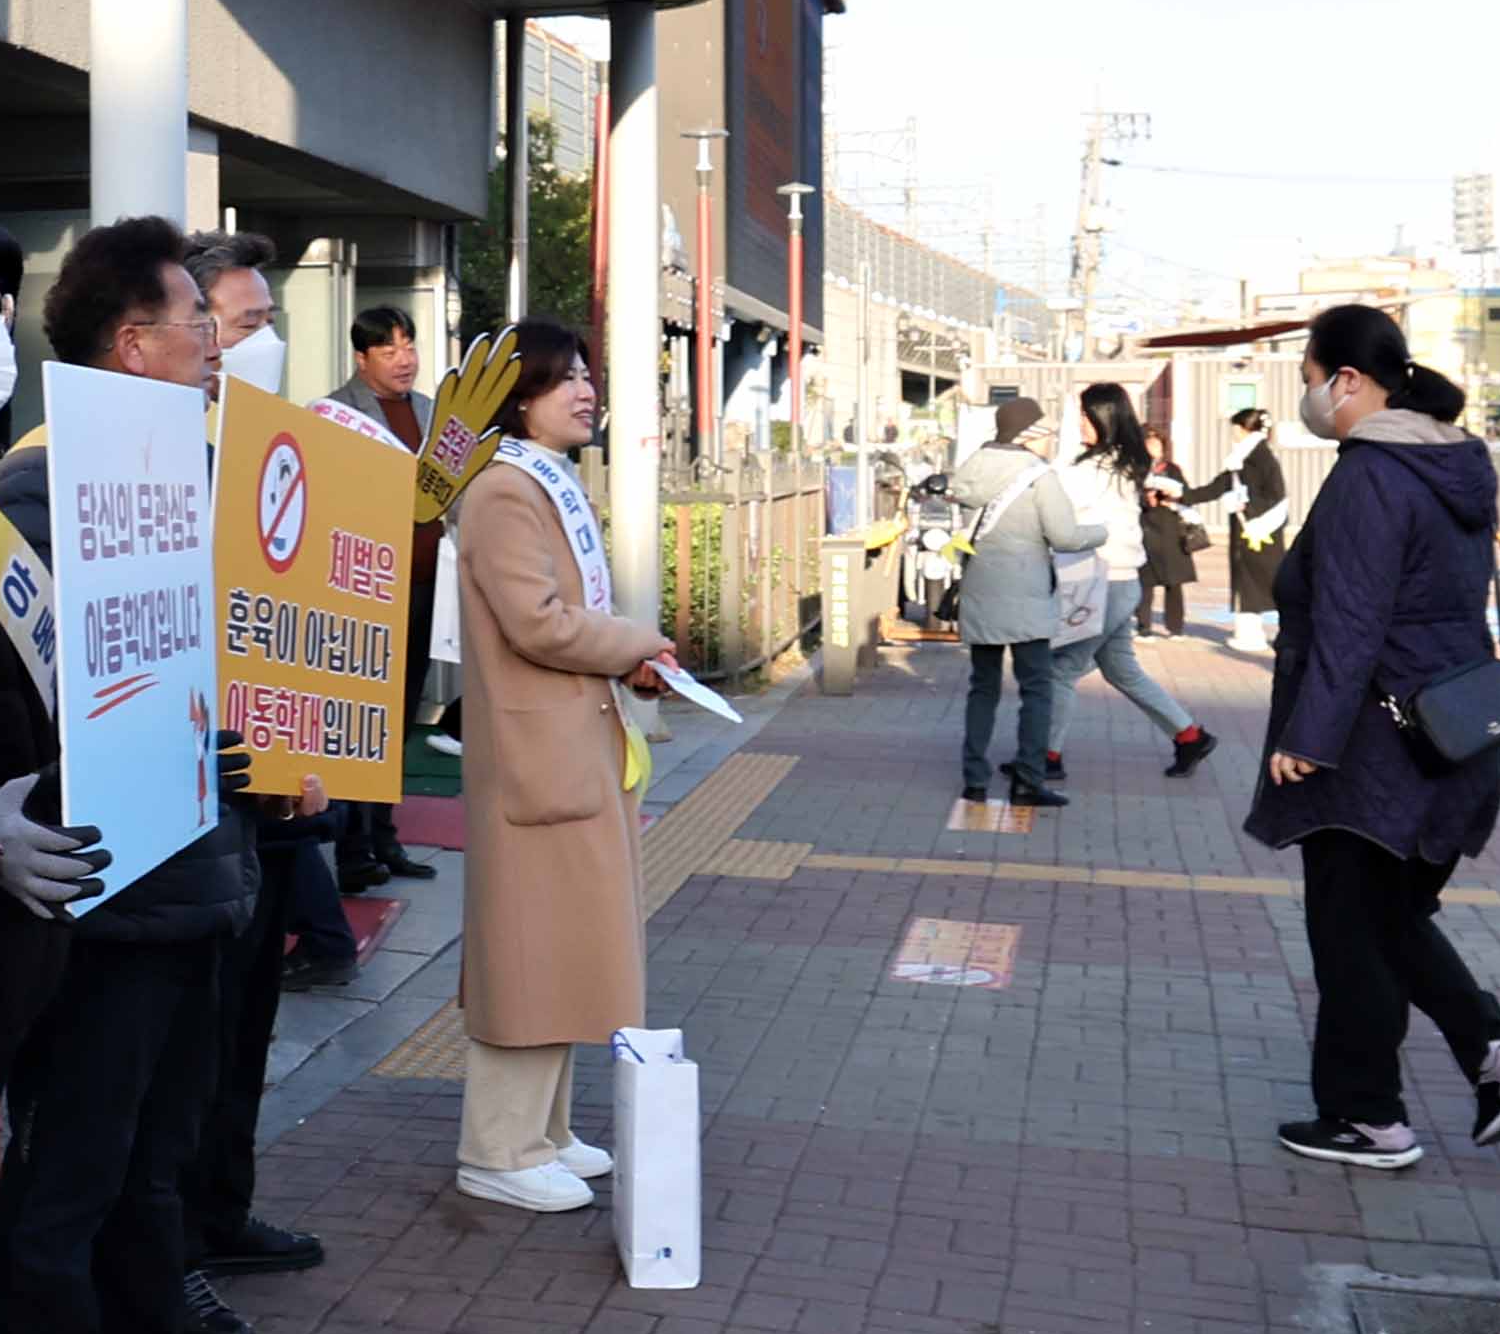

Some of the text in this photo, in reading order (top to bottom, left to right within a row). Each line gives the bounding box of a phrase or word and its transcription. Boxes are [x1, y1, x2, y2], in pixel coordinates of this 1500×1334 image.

[76, 481, 199, 561] 당신의 무관심도
[329, 528, 395, 603] 체벌은
[85, 583, 201, 678] 아동학대입니다
[227, 587, 392, 683] 훈육이 아닙니다
[226, 681, 388, 763] 아동학대입니다
